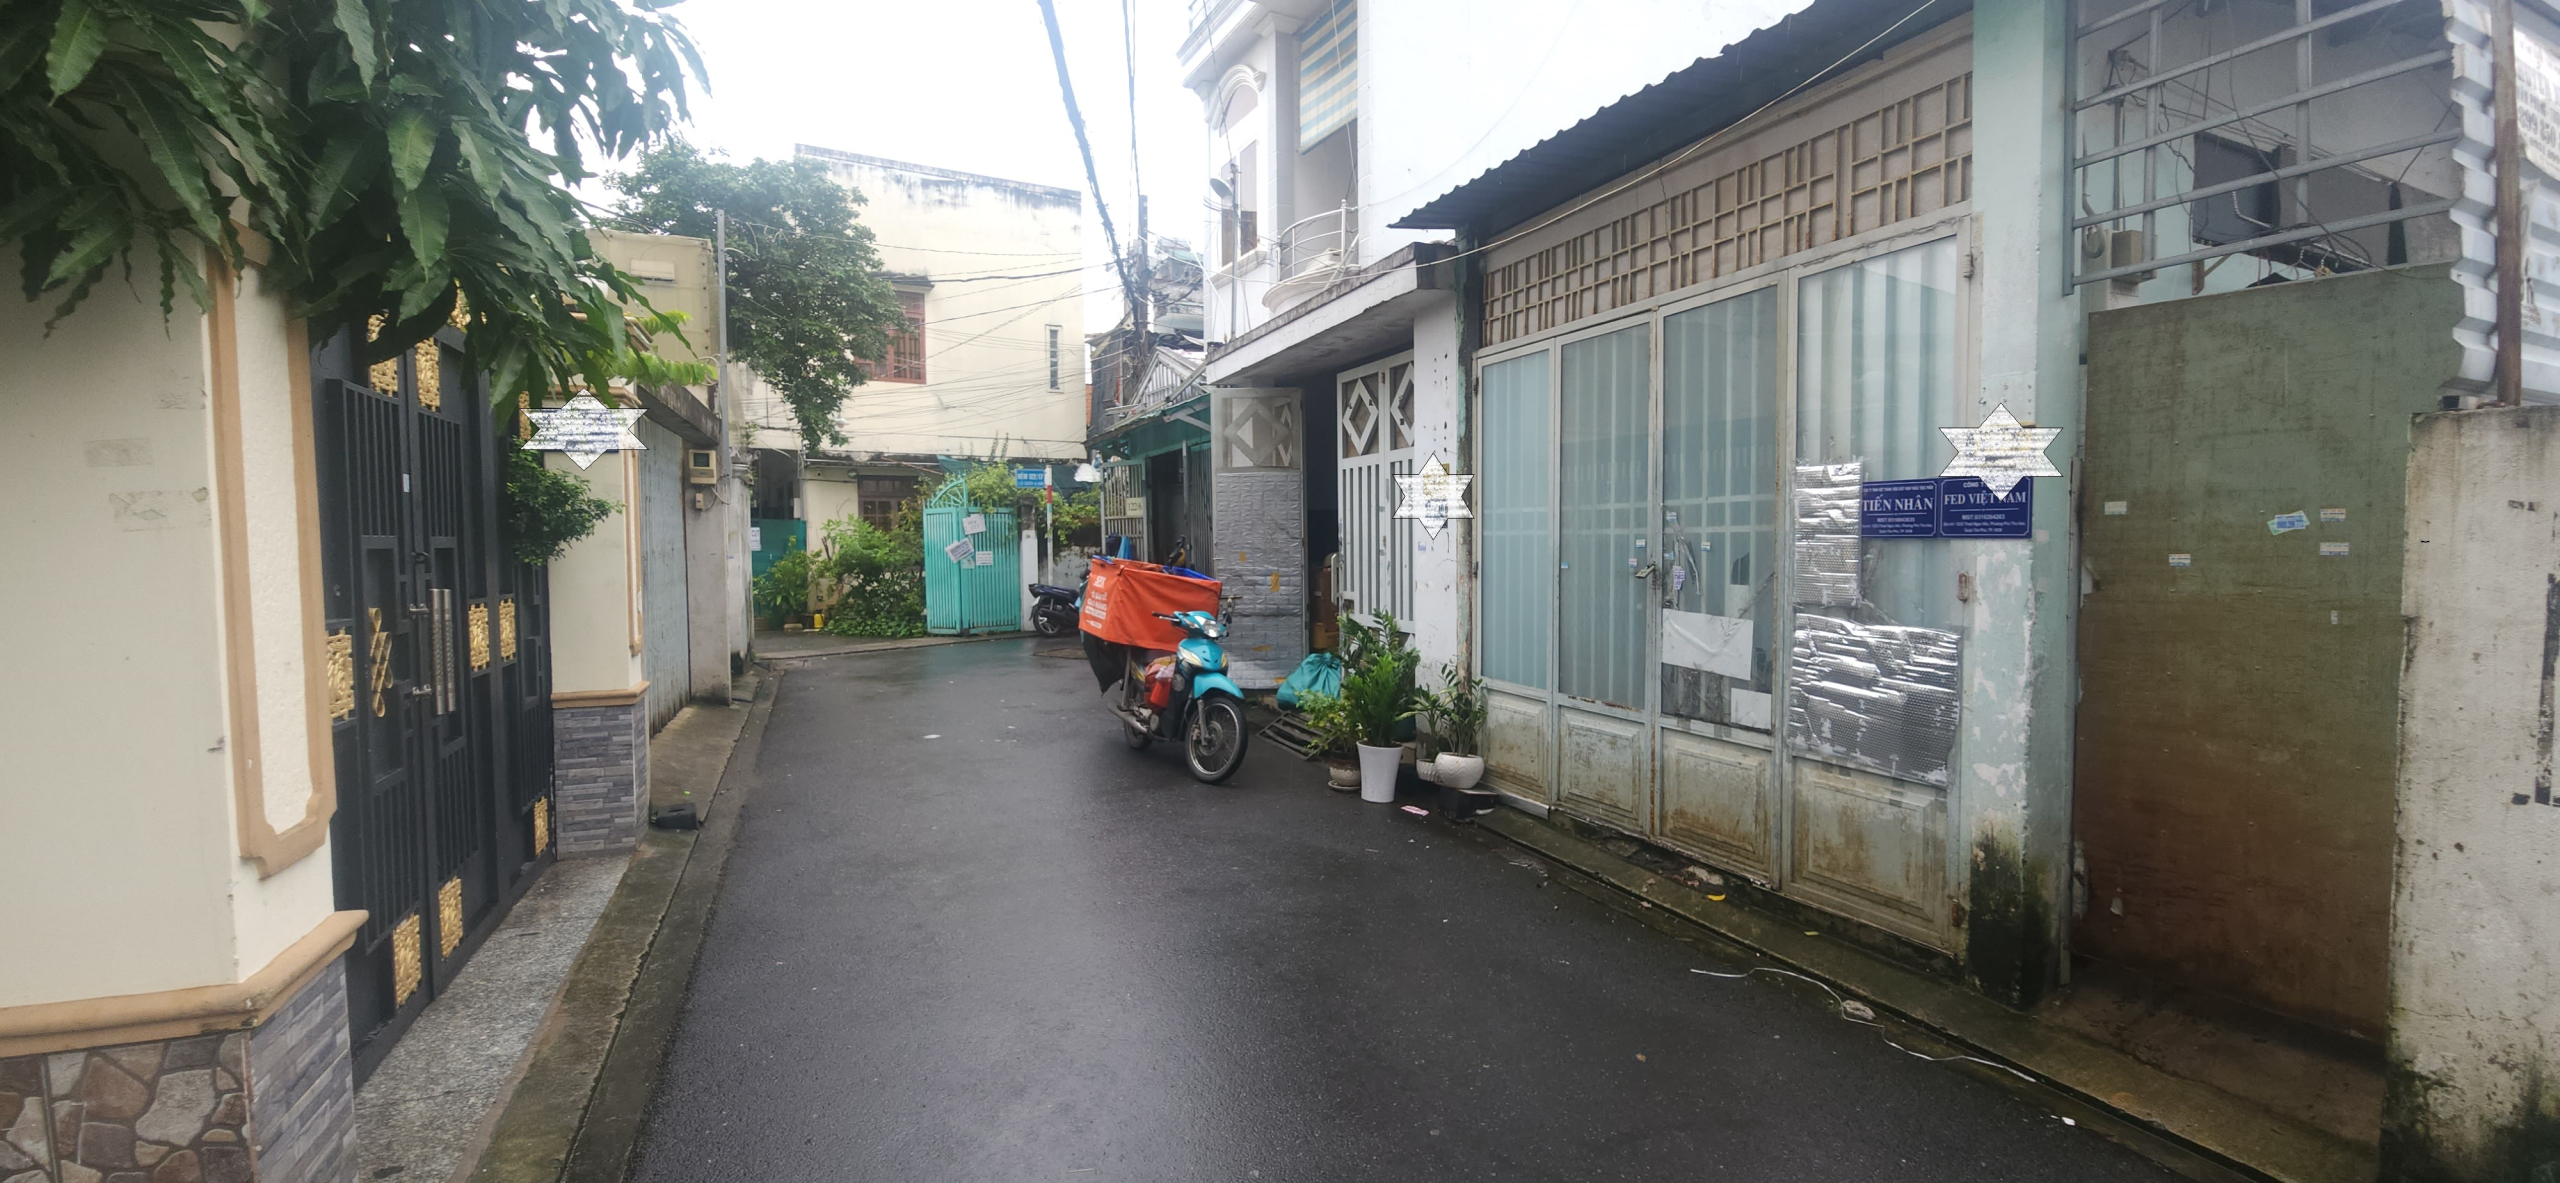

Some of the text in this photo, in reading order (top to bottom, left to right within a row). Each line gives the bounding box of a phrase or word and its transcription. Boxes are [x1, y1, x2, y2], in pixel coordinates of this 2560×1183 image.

[1863, 493, 1934, 511] TIẾN NHÂN
[1944, 494, 1966, 505] FED
[1968, 490, 1995, 506] VIỆT
